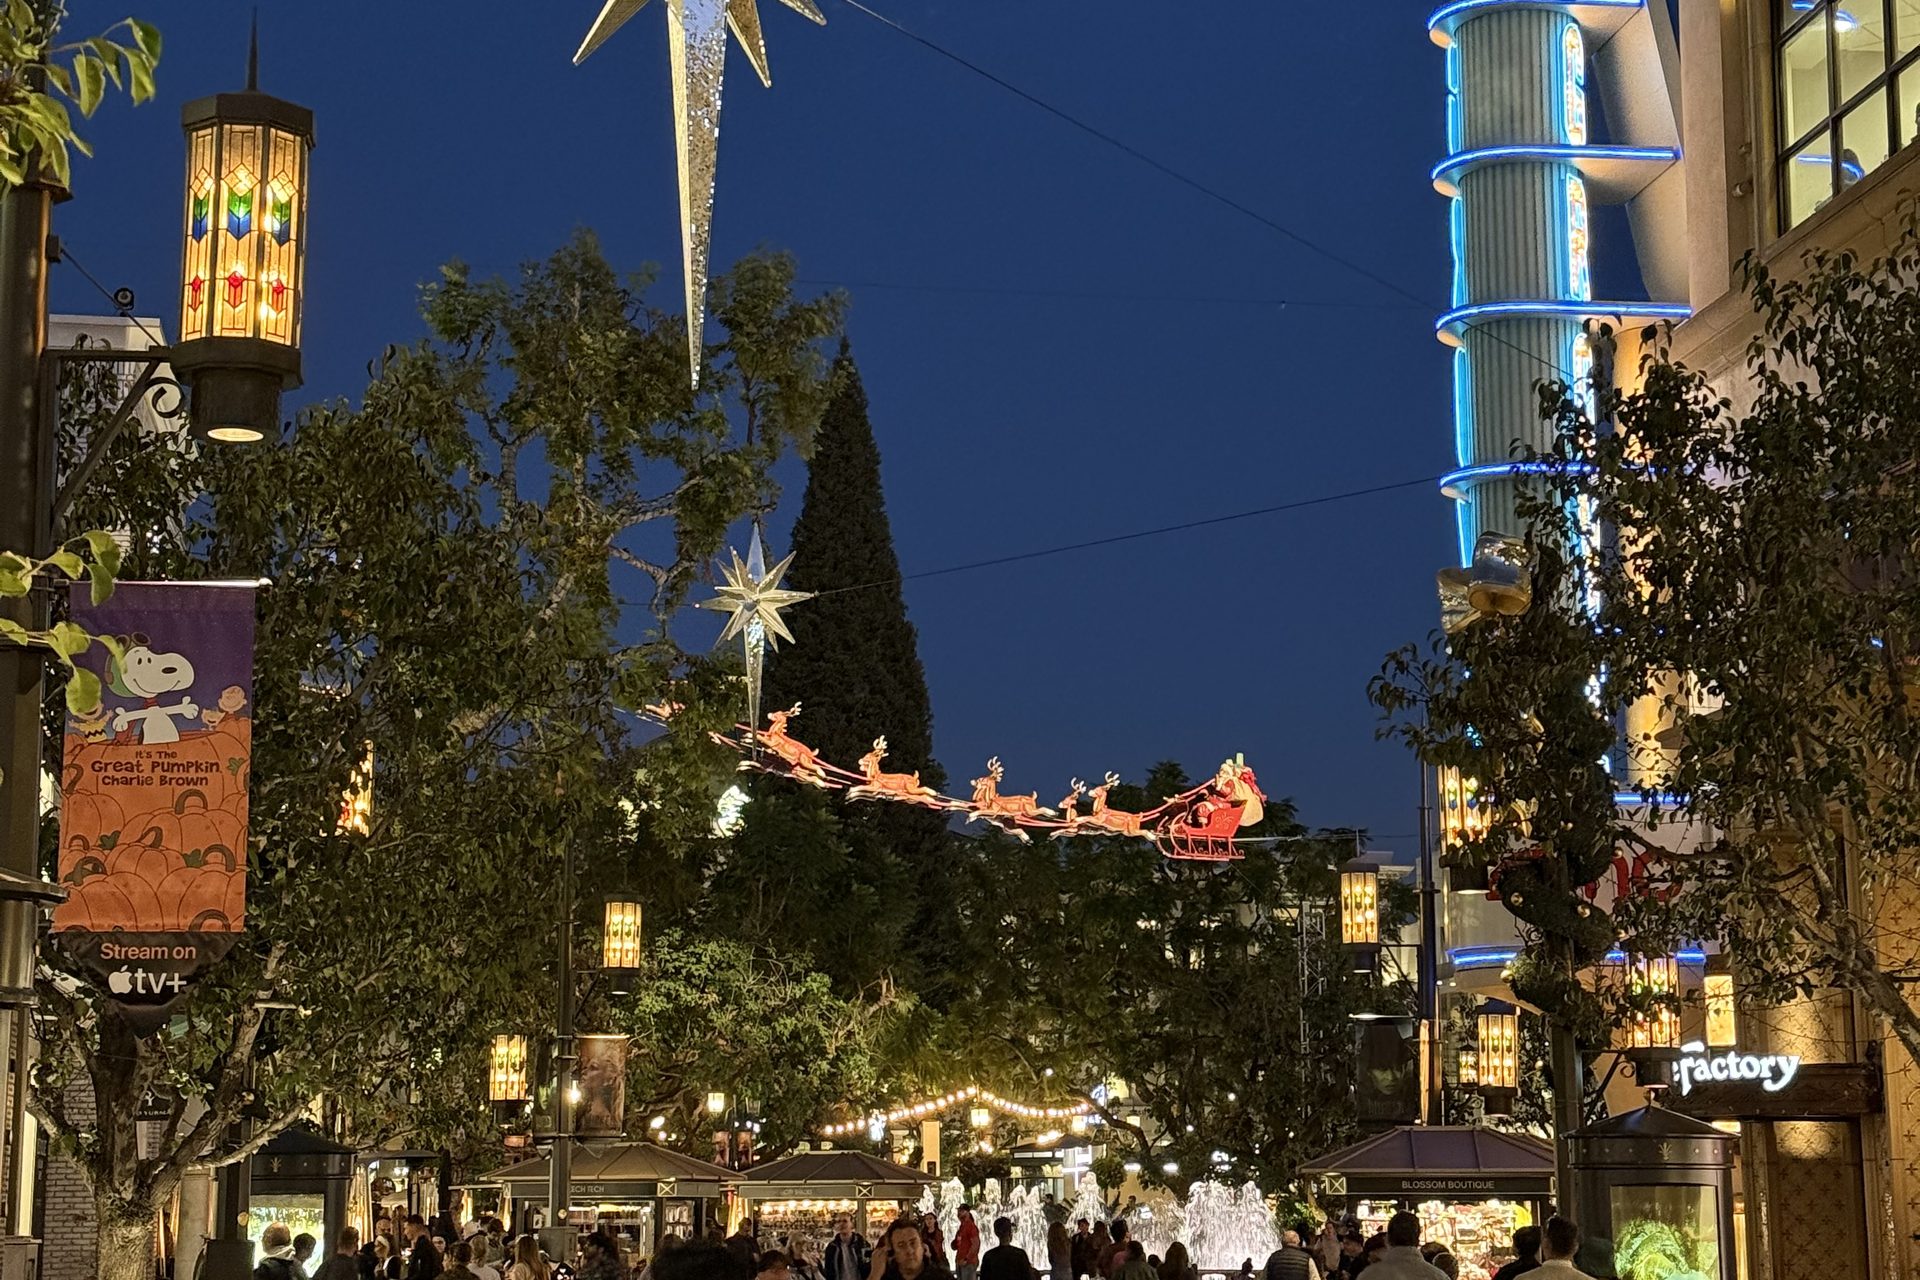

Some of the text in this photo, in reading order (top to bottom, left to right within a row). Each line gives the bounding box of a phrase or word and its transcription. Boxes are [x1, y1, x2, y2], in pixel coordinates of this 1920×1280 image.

[156, 750, 178, 759] The
[91, 760, 144, 773] Great
[101, 775, 208, 786] Charlie Brown
[100, 942, 197, 960] Stream on
[134, 967, 187, 994] tv+
[1401, 1180, 1495, 1189] BLOSSOM BOUTIQUE
